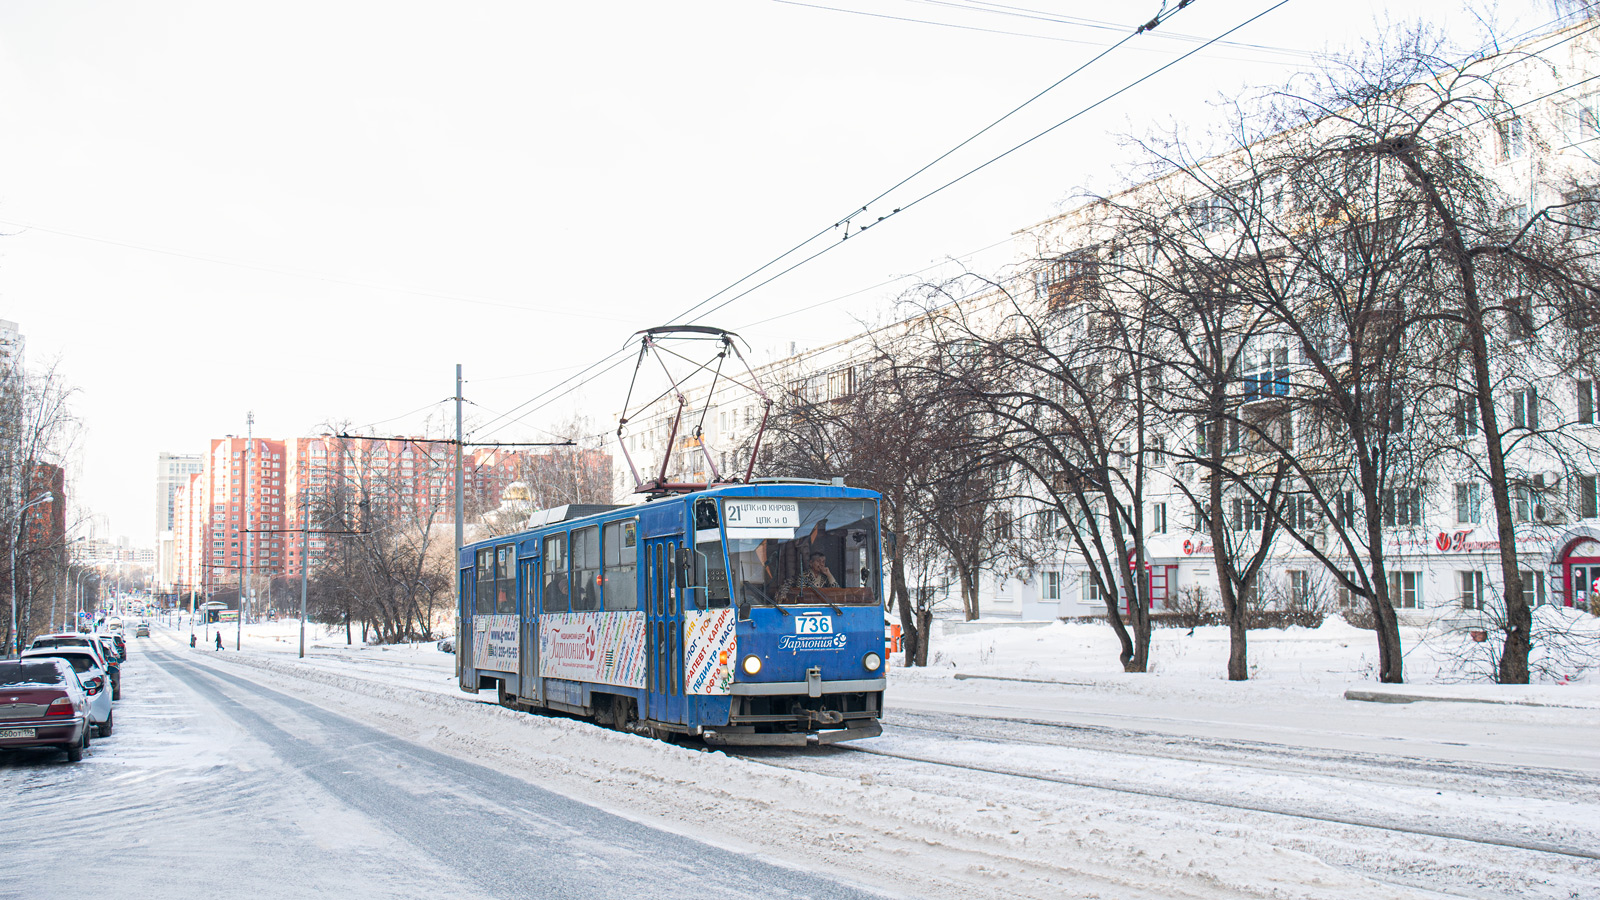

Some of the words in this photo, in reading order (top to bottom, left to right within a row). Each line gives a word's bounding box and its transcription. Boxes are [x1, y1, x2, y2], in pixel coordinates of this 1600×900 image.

[728, 505, 741, 521] 21
[755, 516, 772, 524] ЦПК
[797, 617, 830, 633] 736
[549, 628, 585, 665] Гармония
[778, 634, 833, 651] Гармония
[692, 649, 718, 693] ПЕДИАТР
[719, 617, 736, 646] МАСС
